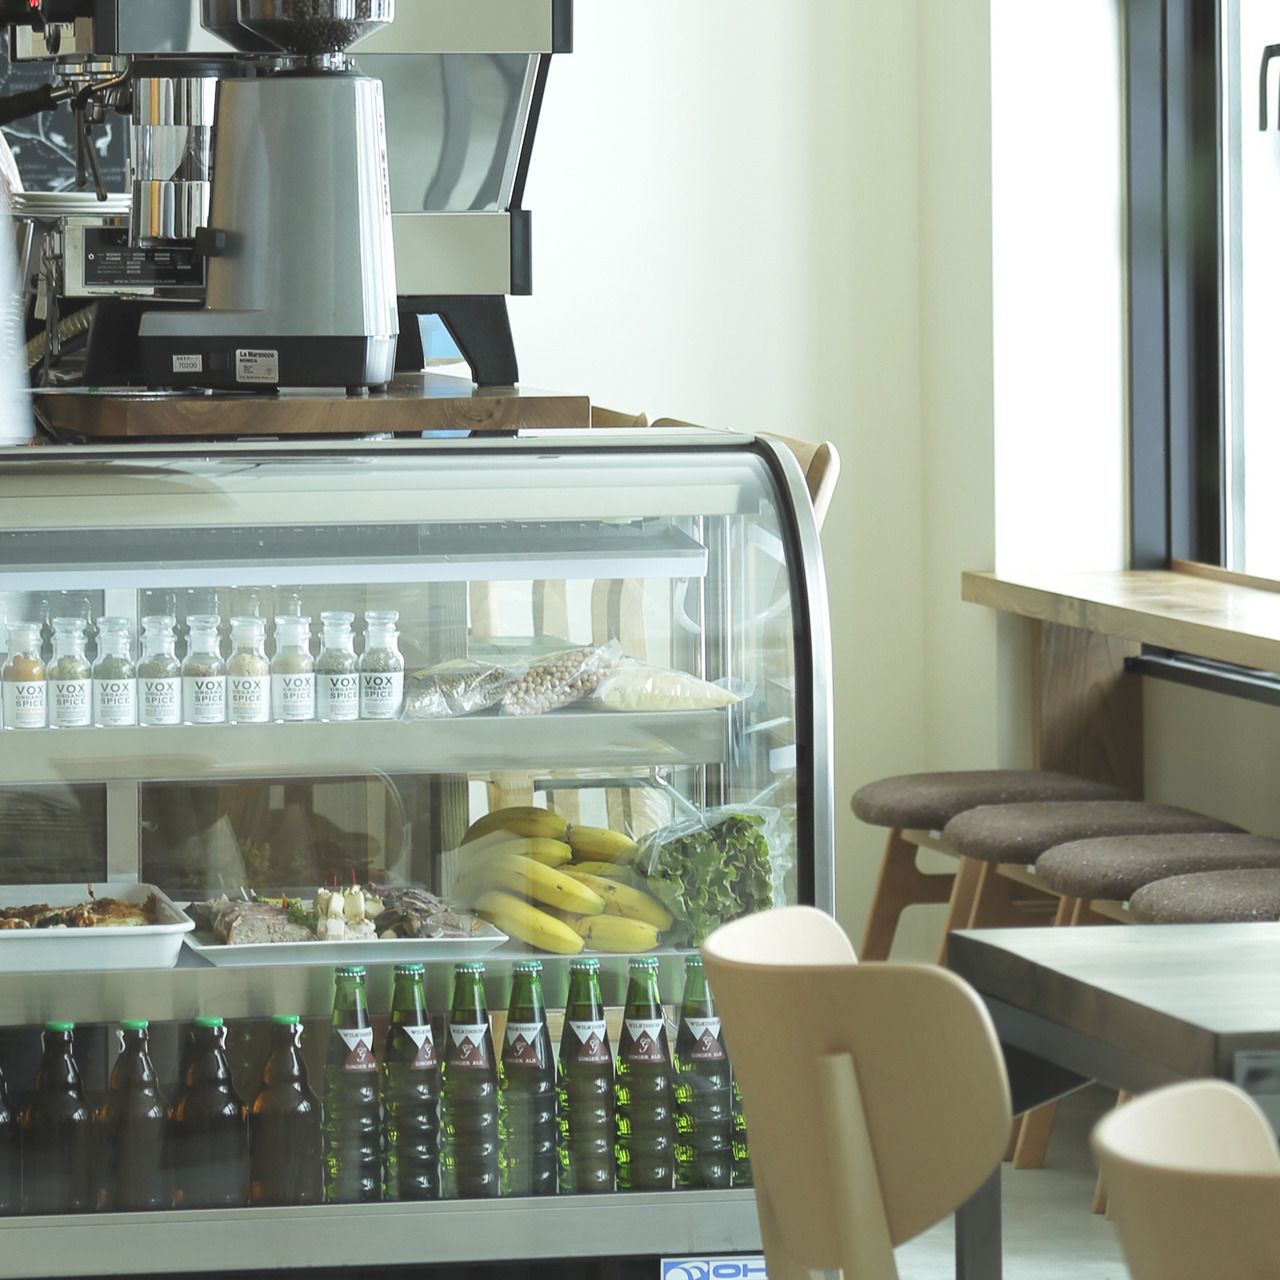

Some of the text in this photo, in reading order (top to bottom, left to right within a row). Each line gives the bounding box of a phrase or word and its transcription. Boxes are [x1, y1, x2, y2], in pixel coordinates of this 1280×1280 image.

[195, 681, 222, 689] VOX
[233, 680, 261, 689] VOX
[283, 678, 311, 687] VOX
[330, 678, 357, 687] VOX
[365, 676, 392, 686] VOX
[16, 686, 43, 695] VOX
[56, 684, 85, 692] VOX
[101, 683, 129, 692] VOX
[146, 682, 174, 691] VOX
